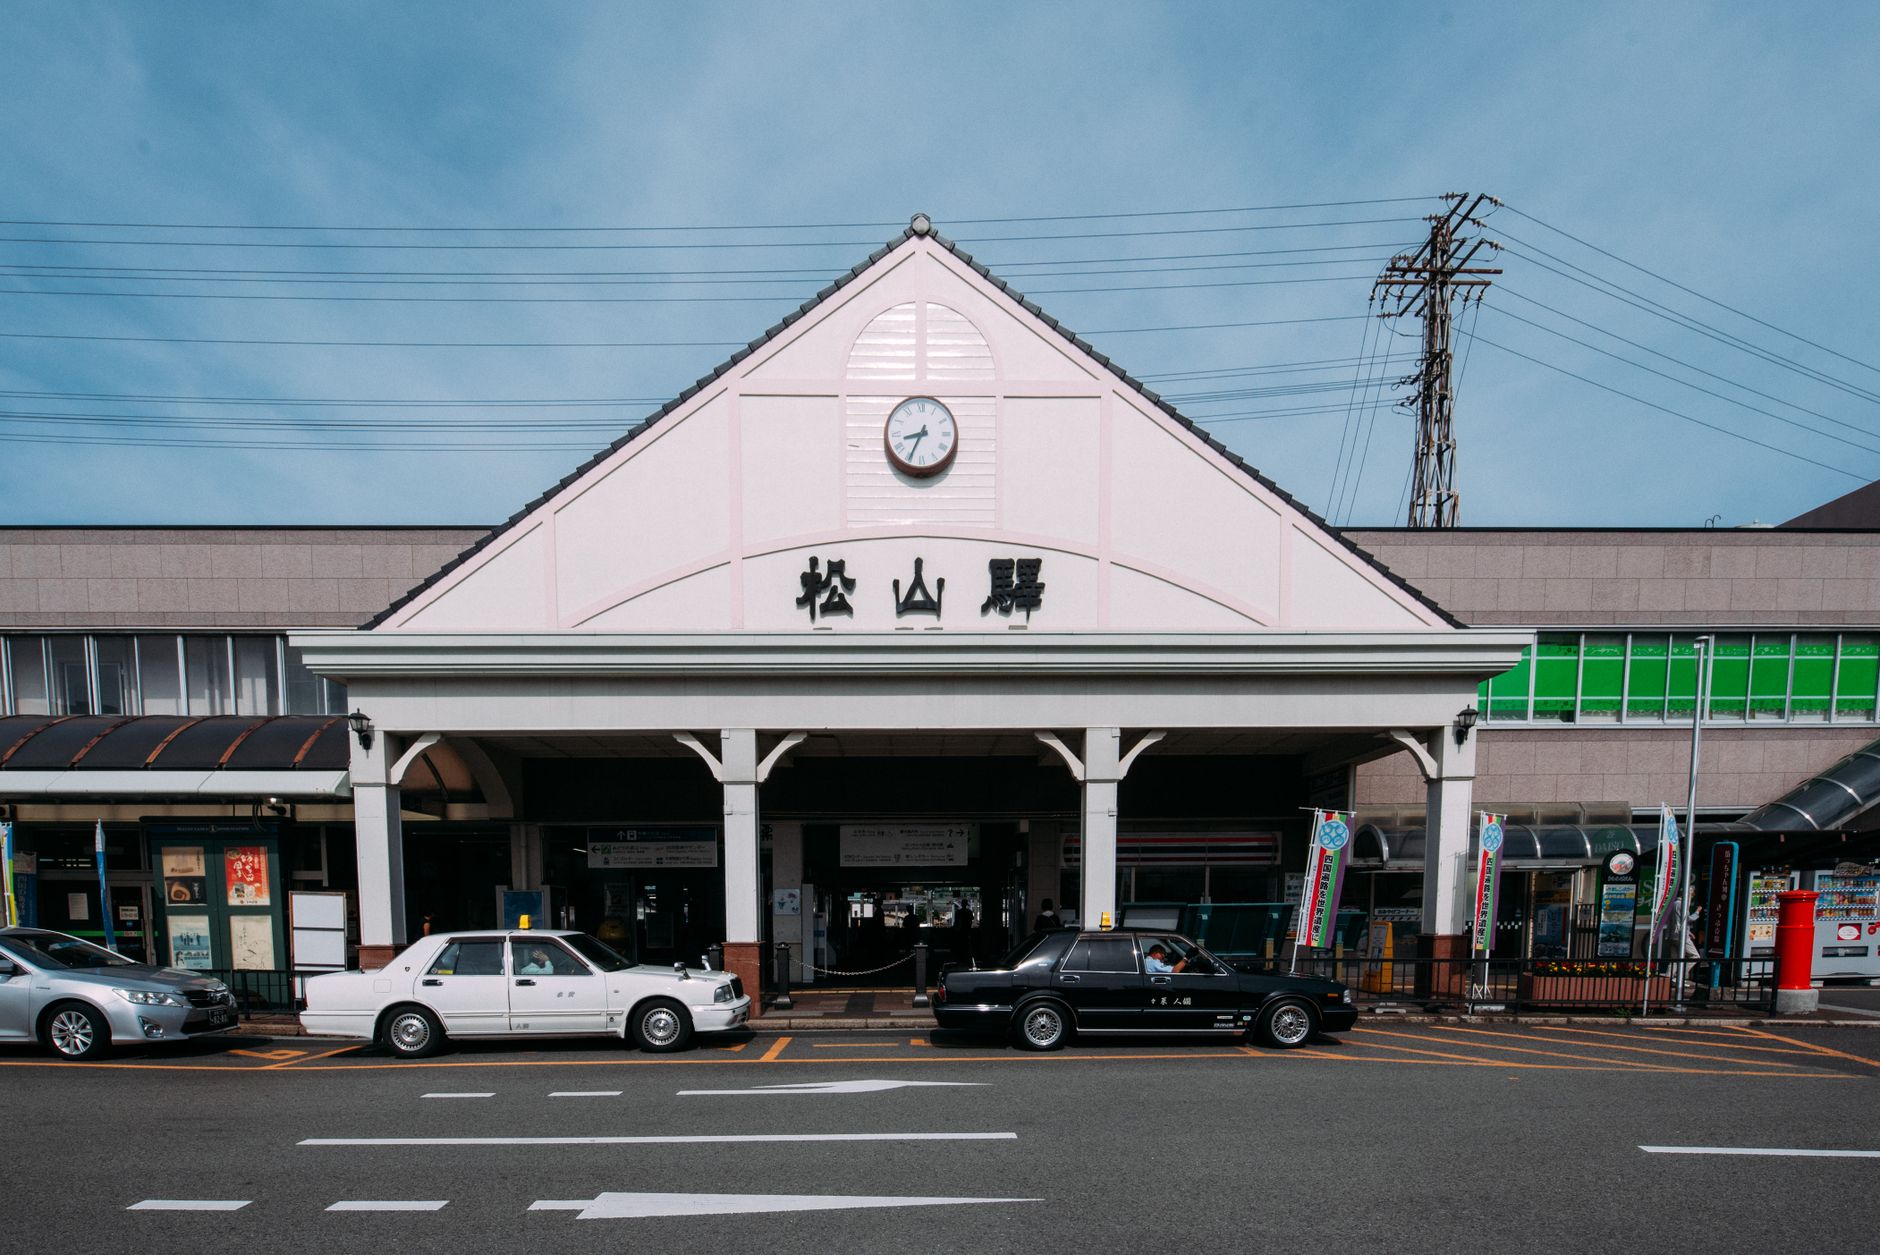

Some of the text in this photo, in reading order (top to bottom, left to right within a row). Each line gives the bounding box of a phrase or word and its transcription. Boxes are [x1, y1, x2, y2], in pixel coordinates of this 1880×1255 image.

[795, 555, 1046, 622] 松山驛
[1311, 854, 1334, 942] 四国遍路を世界遺産に
[1475, 857, 1493, 944] 四国遍路を世界遺産に
